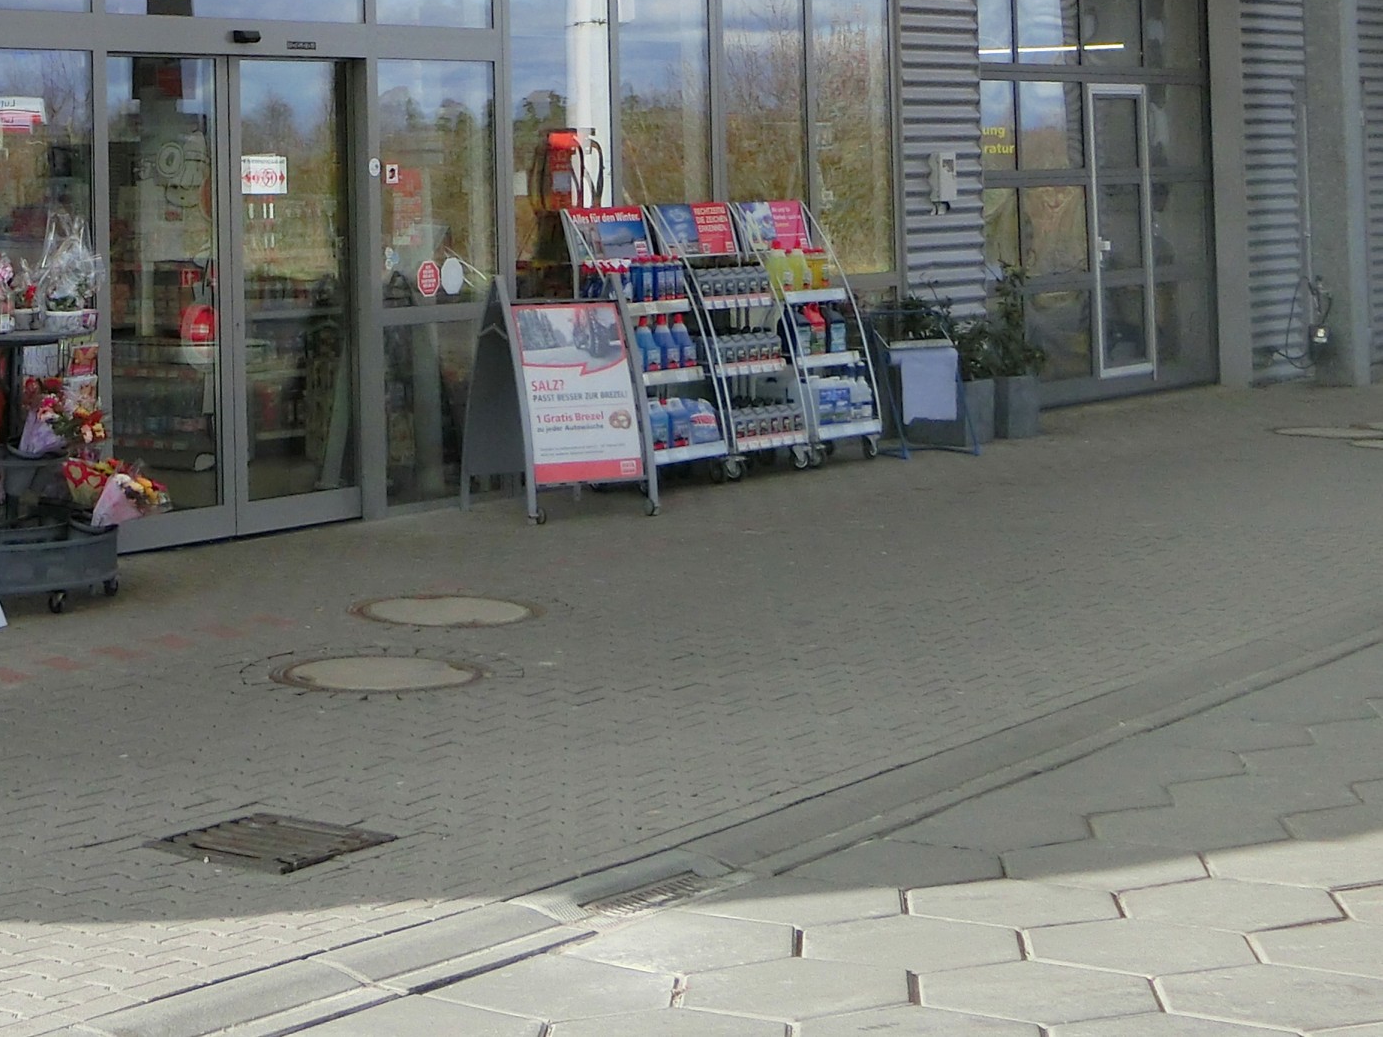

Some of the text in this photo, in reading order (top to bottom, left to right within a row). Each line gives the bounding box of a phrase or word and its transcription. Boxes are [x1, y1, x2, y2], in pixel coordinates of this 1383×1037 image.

[982, 126, 1005, 139] ung
[984, 143, 1015, 154] ratur
[572, 214, 589, 223] Alles
[590, 213, 601, 223] für
[602, 212, 615, 222] den
[532, 380, 564, 391] SALZ?
[533, 394, 554, 402] PASST
[557, 392, 582, 401] BESSER
[585, 391, 598, 400] ZUR
[543, 413, 573, 423] Gratis
[575, 411, 604, 421] Brezel
